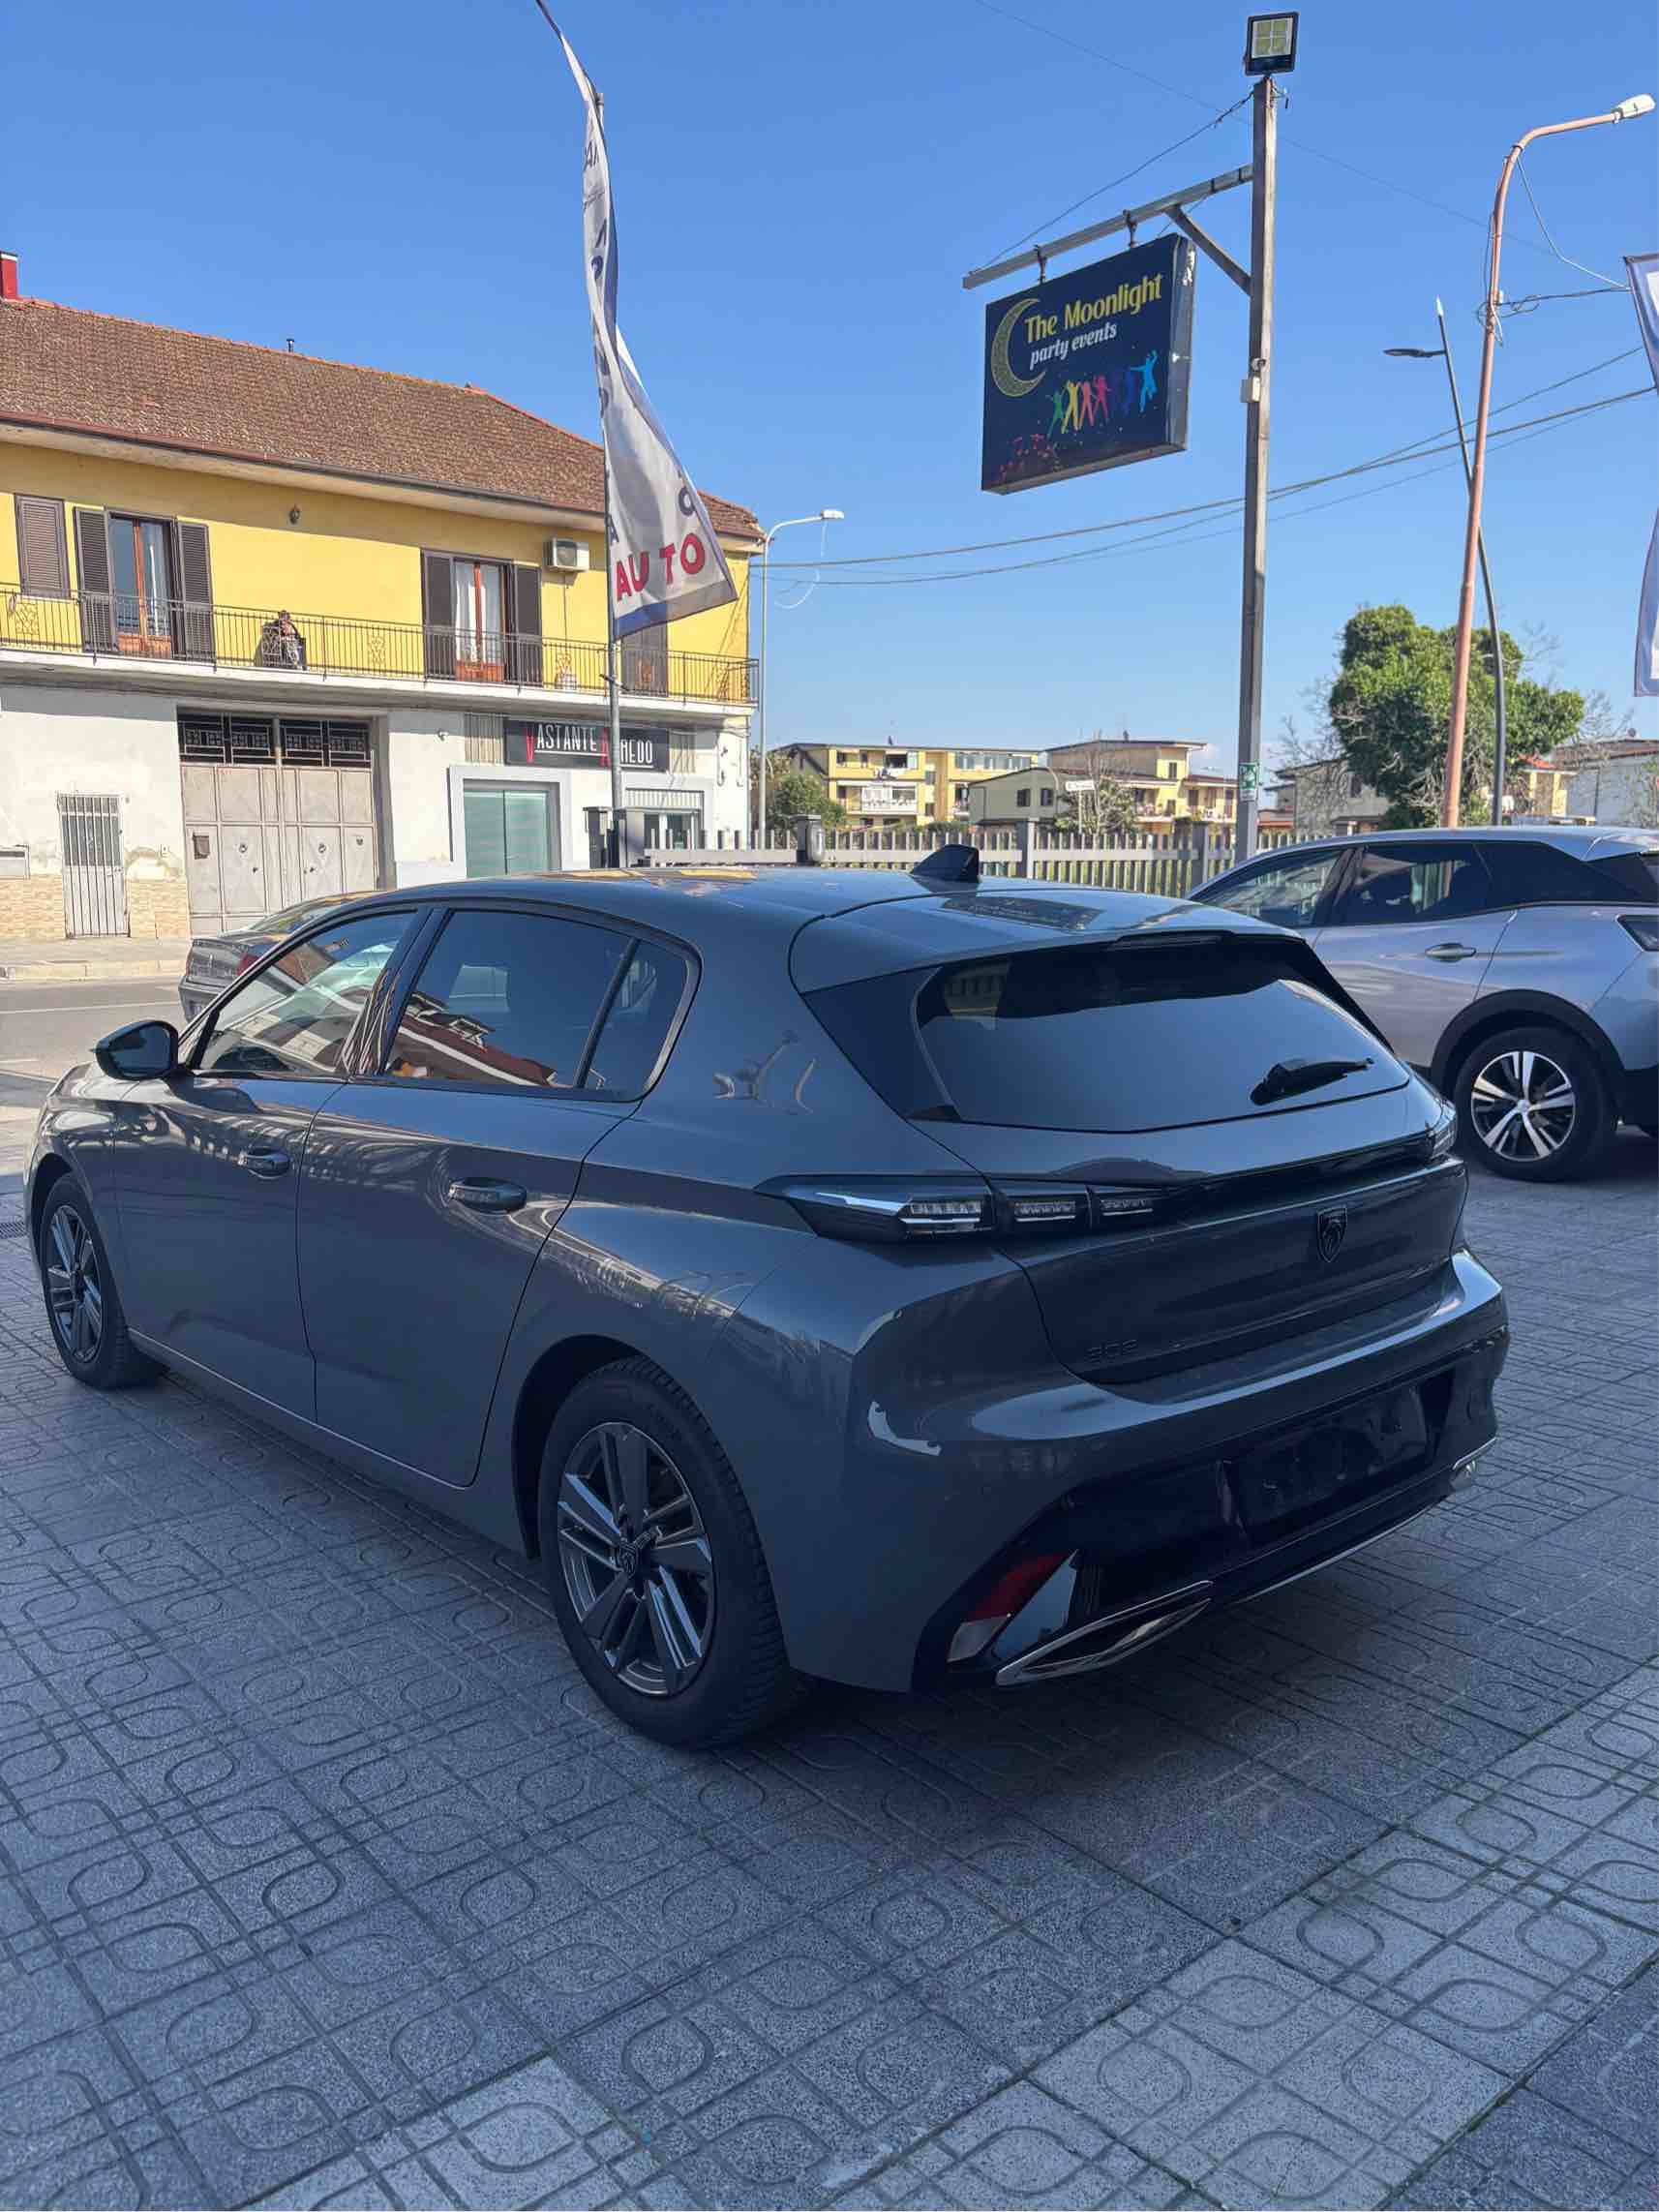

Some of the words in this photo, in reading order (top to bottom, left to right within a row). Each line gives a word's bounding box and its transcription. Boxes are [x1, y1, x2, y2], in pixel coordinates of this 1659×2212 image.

[1024, 315, 1057, 344] The
[1065, 274, 1163, 330] Moonlight
[1030, 338, 1070, 369] party
[1072, 321, 1117, 351] events
[616, 533, 706, 601] AUTO
[525, 724, 597, 764] VASTANTE
